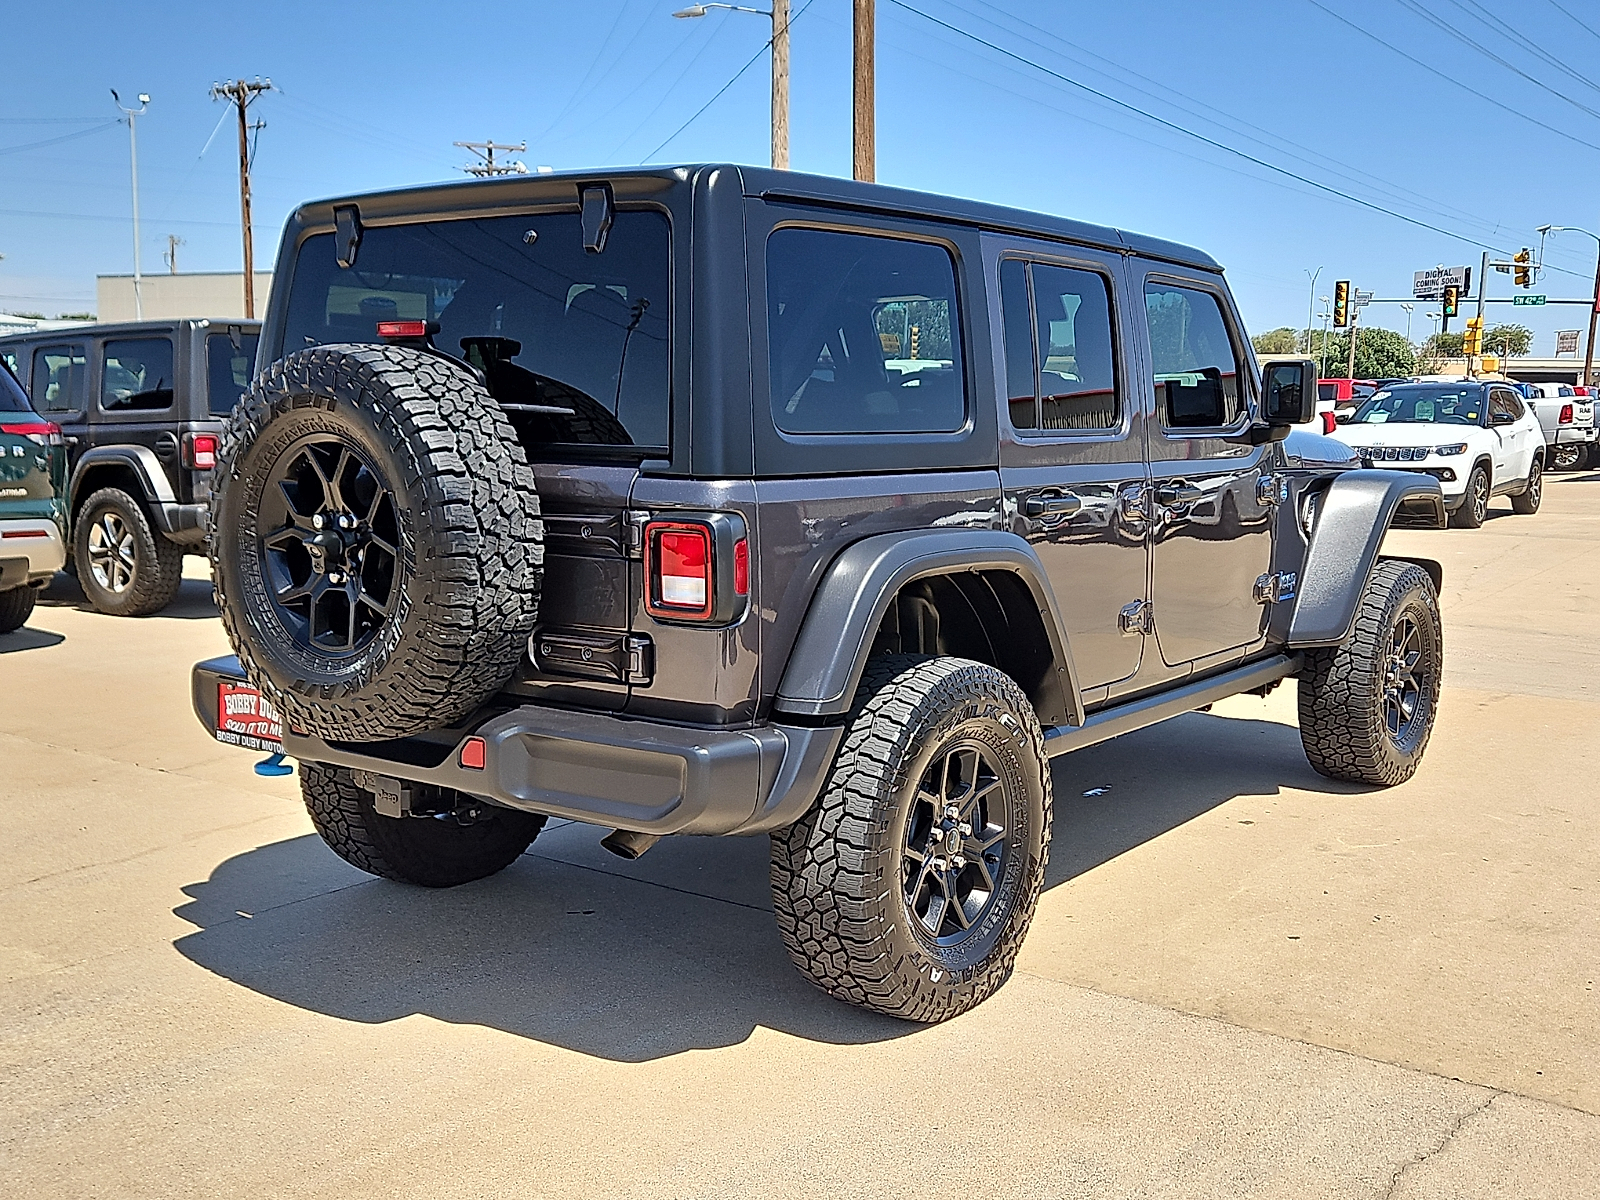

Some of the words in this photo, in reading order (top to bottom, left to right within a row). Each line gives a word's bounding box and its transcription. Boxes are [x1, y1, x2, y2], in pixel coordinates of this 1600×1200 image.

[1425, 268, 1452, 279] DIGITAL
[1416, 278, 1439, 287] COMING
[1441, 276, 1461, 285] SOON!
[1515, 297, 1524, 305] SW
[224, 693, 257, 715] BOBBY
[225, 719, 246, 733] SOLD
[246, 722, 257, 734] IT
[257, 721, 268, 735] TO
[216, 730, 241, 744] BOBBY
[241, 735, 261, 749] DUBY
[378, 789, 398, 804] Jeep
